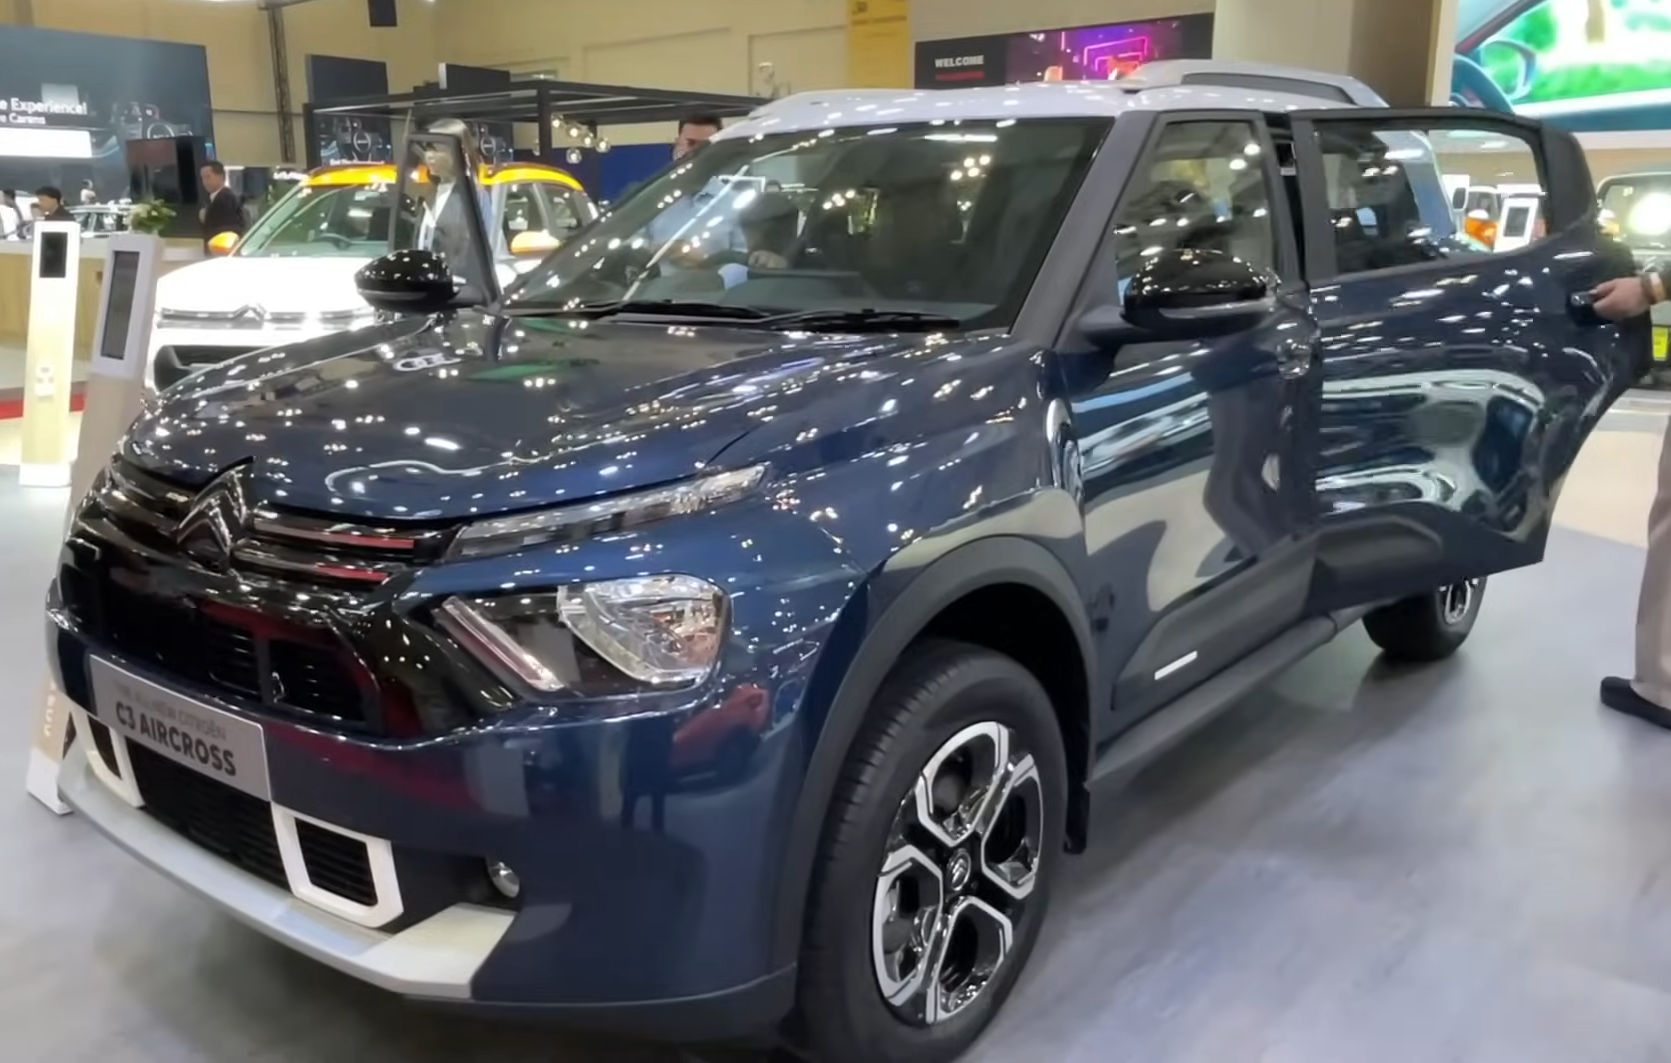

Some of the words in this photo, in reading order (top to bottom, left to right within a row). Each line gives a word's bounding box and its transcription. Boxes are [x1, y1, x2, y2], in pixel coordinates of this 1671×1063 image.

[935, 55, 984, 68] WELCOME
[10, 97, 88, 115] Experience!
[116, 701, 136, 730] C3
[140, 713, 237, 776] AIRCROSS
